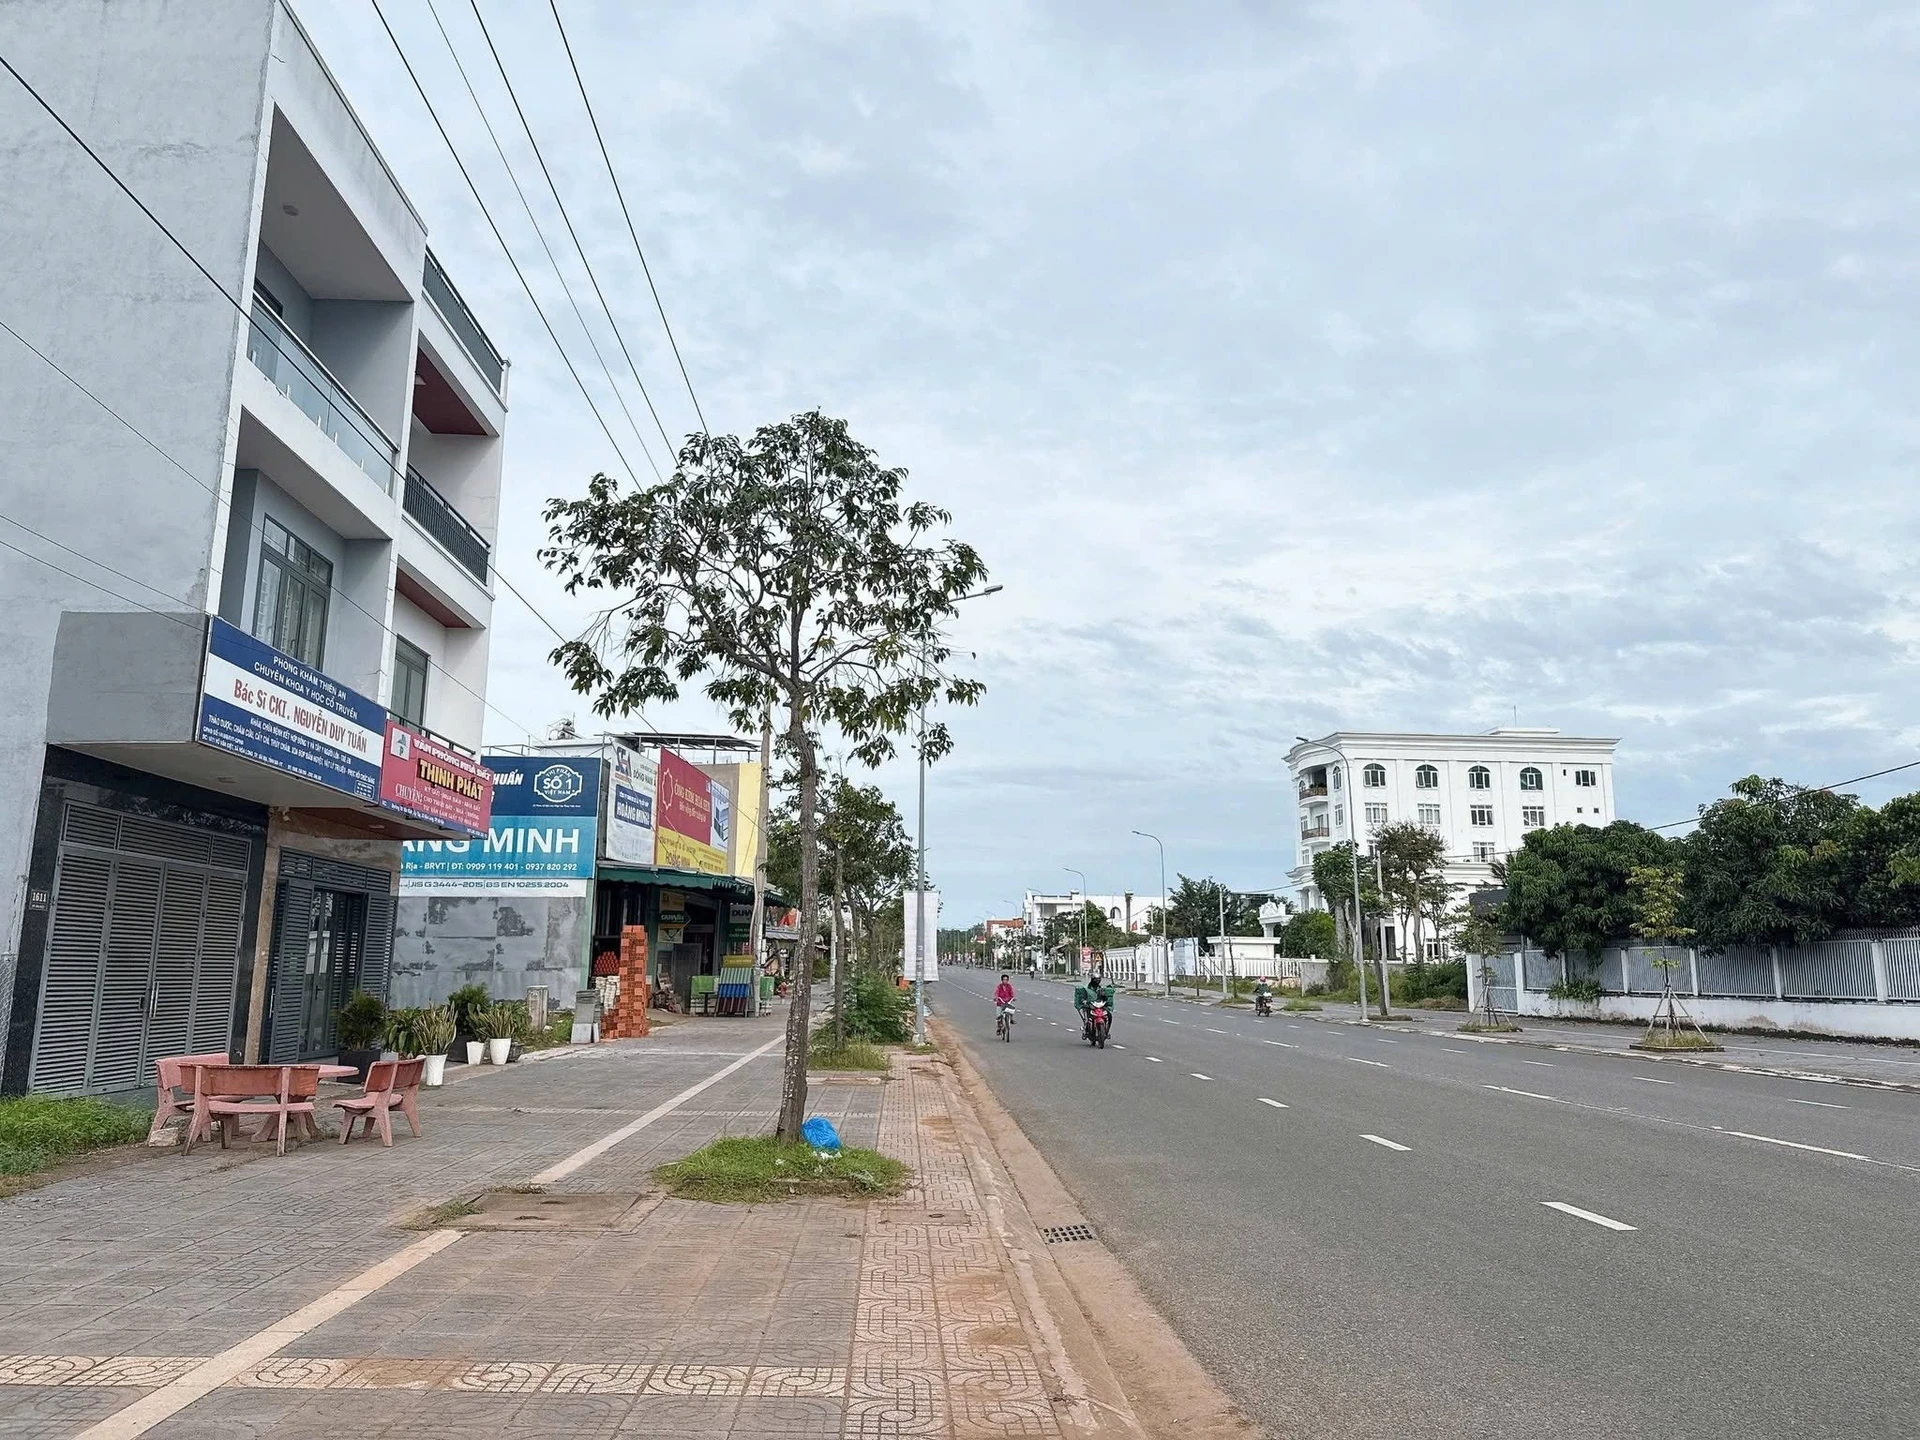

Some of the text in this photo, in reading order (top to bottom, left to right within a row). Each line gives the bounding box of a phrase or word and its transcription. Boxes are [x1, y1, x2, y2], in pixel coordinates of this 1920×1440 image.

[254, 661, 358, 720] CHUYÊN KHOA Y HỌC CỔ TRUYỀN
[274, 656, 298, 675] PHÒNG
[300, 669, 318, 686] KHÁM
[338, 689, 346, 700] AN
[234, 679, 253, 704] Bác
[257, 689, 268, 710] Sĩ
[294, 706, 328, 736] NGUYỄN
[330, 720, 349, 743] DUY
[348, 730, 368, 753] TUẤN
[432, 748, 459, 767] PHÒNG
[420, 760, 454, 789] THỊNH
[457, 778, 484, 800] PHÁT
[542, 774, 572, 790] SỐ 1
[484, 828, 580, 853] MINH
[405, 862, 418, 871] Rịa
[32, 892, 47, 902] 1611
